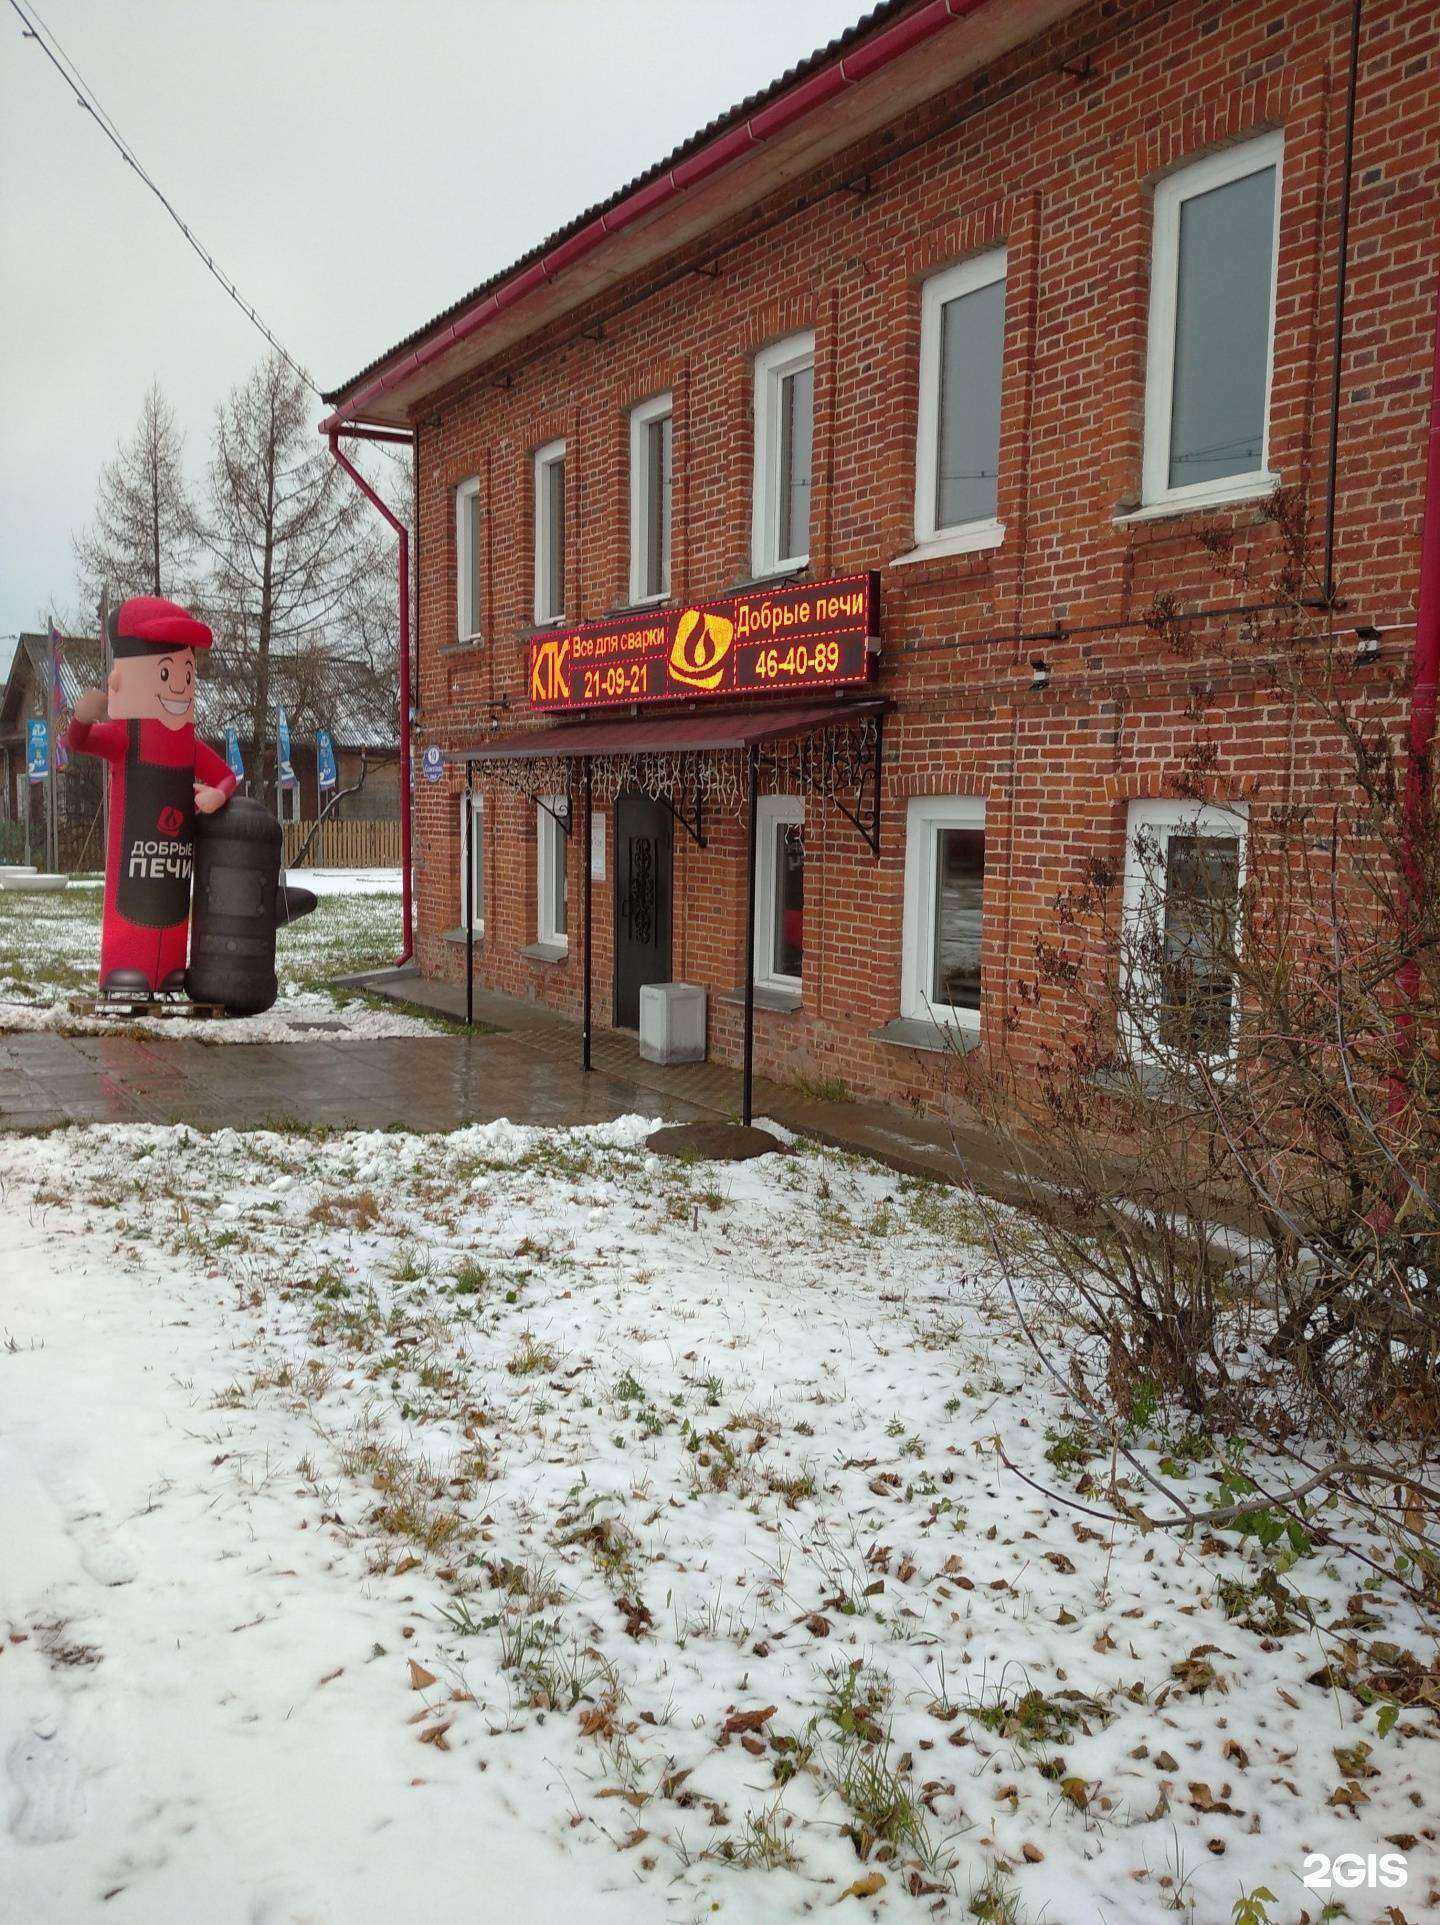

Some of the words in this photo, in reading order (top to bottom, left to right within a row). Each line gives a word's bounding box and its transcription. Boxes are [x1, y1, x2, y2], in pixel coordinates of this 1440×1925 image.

[737, 600, 810, 638] Добрые
[816, 592, 863, 620] печи
[573, 635, 594, 658] Все
[595, 635, 618, 658] для
[620, 626, 665, 654] сварки
[755, 641, 839, 678] 46-40-89
[584, 663, 647, 698] 21-09-21
[131, 841, 193, 857] ДОБРЫЕ
[128, 857, 192, 879] ПЕЧИ
